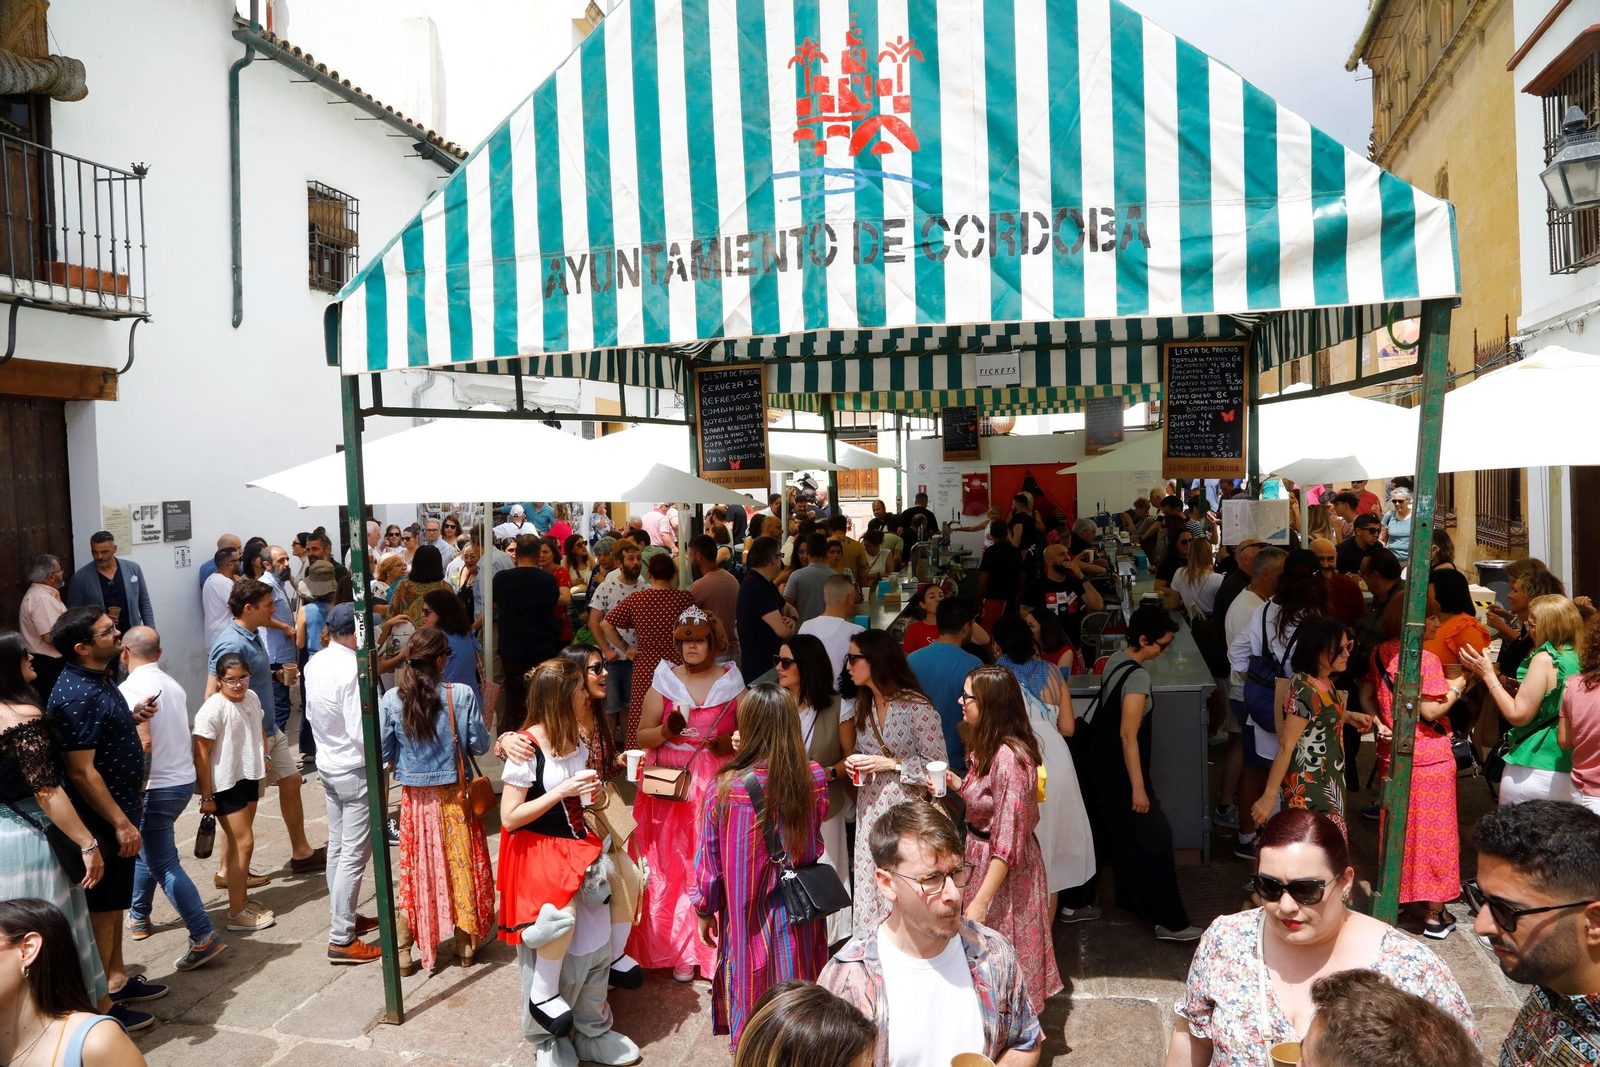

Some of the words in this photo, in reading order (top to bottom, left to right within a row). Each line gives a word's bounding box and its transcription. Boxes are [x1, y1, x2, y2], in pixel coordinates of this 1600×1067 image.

[545, 223, 837, 298] AYUNTAMIENTO
[853, 219, 905, 265] DE
[921, 206, 1151, 262] CORDOBA
[979, 366, 1016, 375] TICKETS
[704, 372, 727, 380] LISTA
[702, 392, 750, 406] REFRESCOS
[702, 405, 750, 416] COMBINADO
[704, 416, 732, 426] BOTELLA
